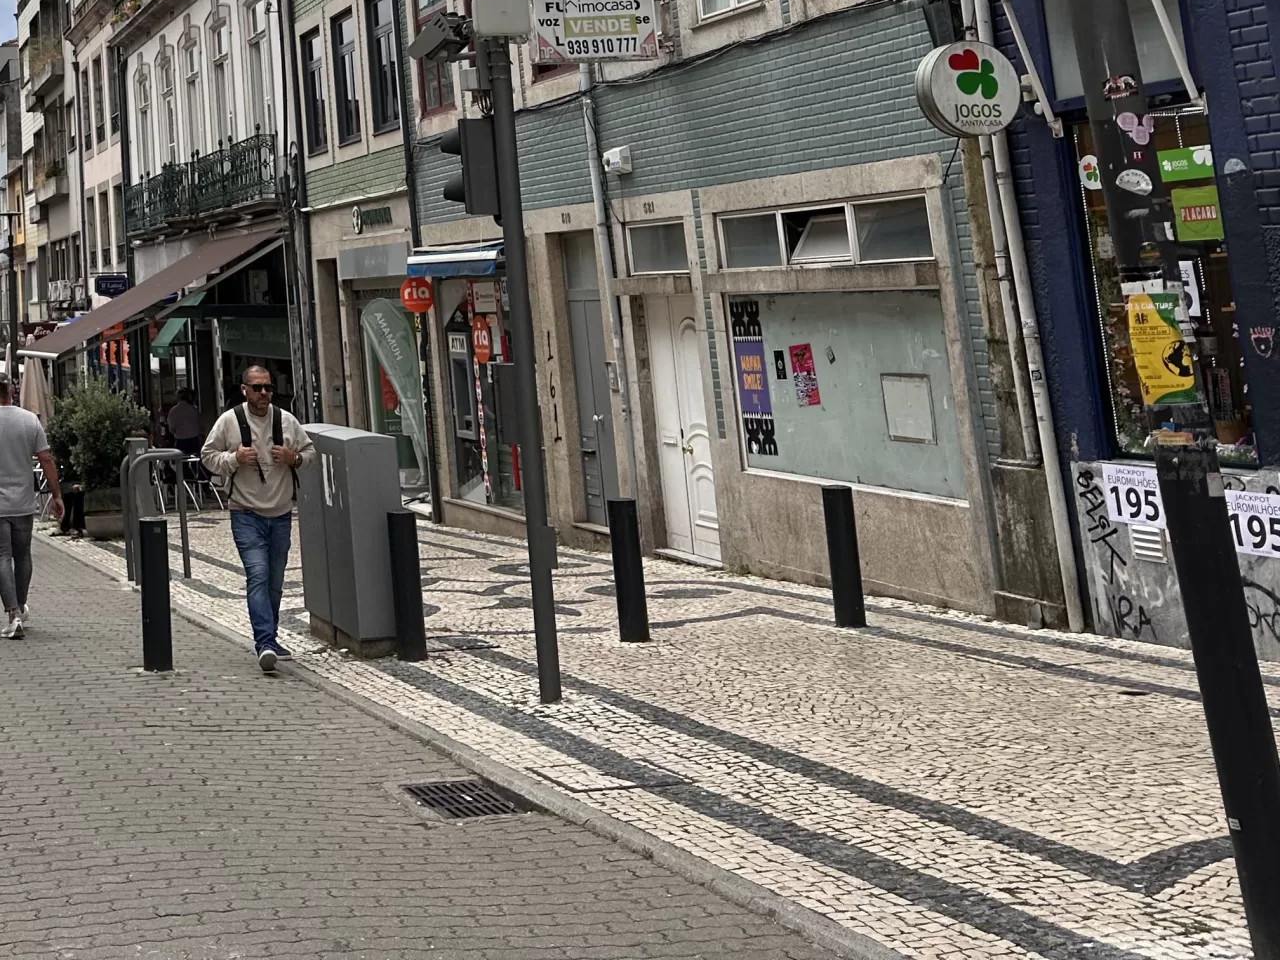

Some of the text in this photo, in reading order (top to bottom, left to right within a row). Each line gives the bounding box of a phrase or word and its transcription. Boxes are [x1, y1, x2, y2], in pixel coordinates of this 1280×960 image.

[570, 18, 632, 34] VENDE
[567, 37, 637, 55] 939 910 777
[954, 103, 1003, 122] JOGOS
[1180, 205, 1217, 221] PLACARD
[404, 282, 430, 300] ria
[474, 322, 489, 346] ria
[451, 337, 465, 351] ATM
[1115, 468, 1146, 477] JACKPOT
[1107, 474, 1157, 489] EUROMILHÕES
[1110, 485, 1160, 522] 195
[1235, 493, 1271, 503] JACKPOT
[1229, 513, 1280, 553] 195
